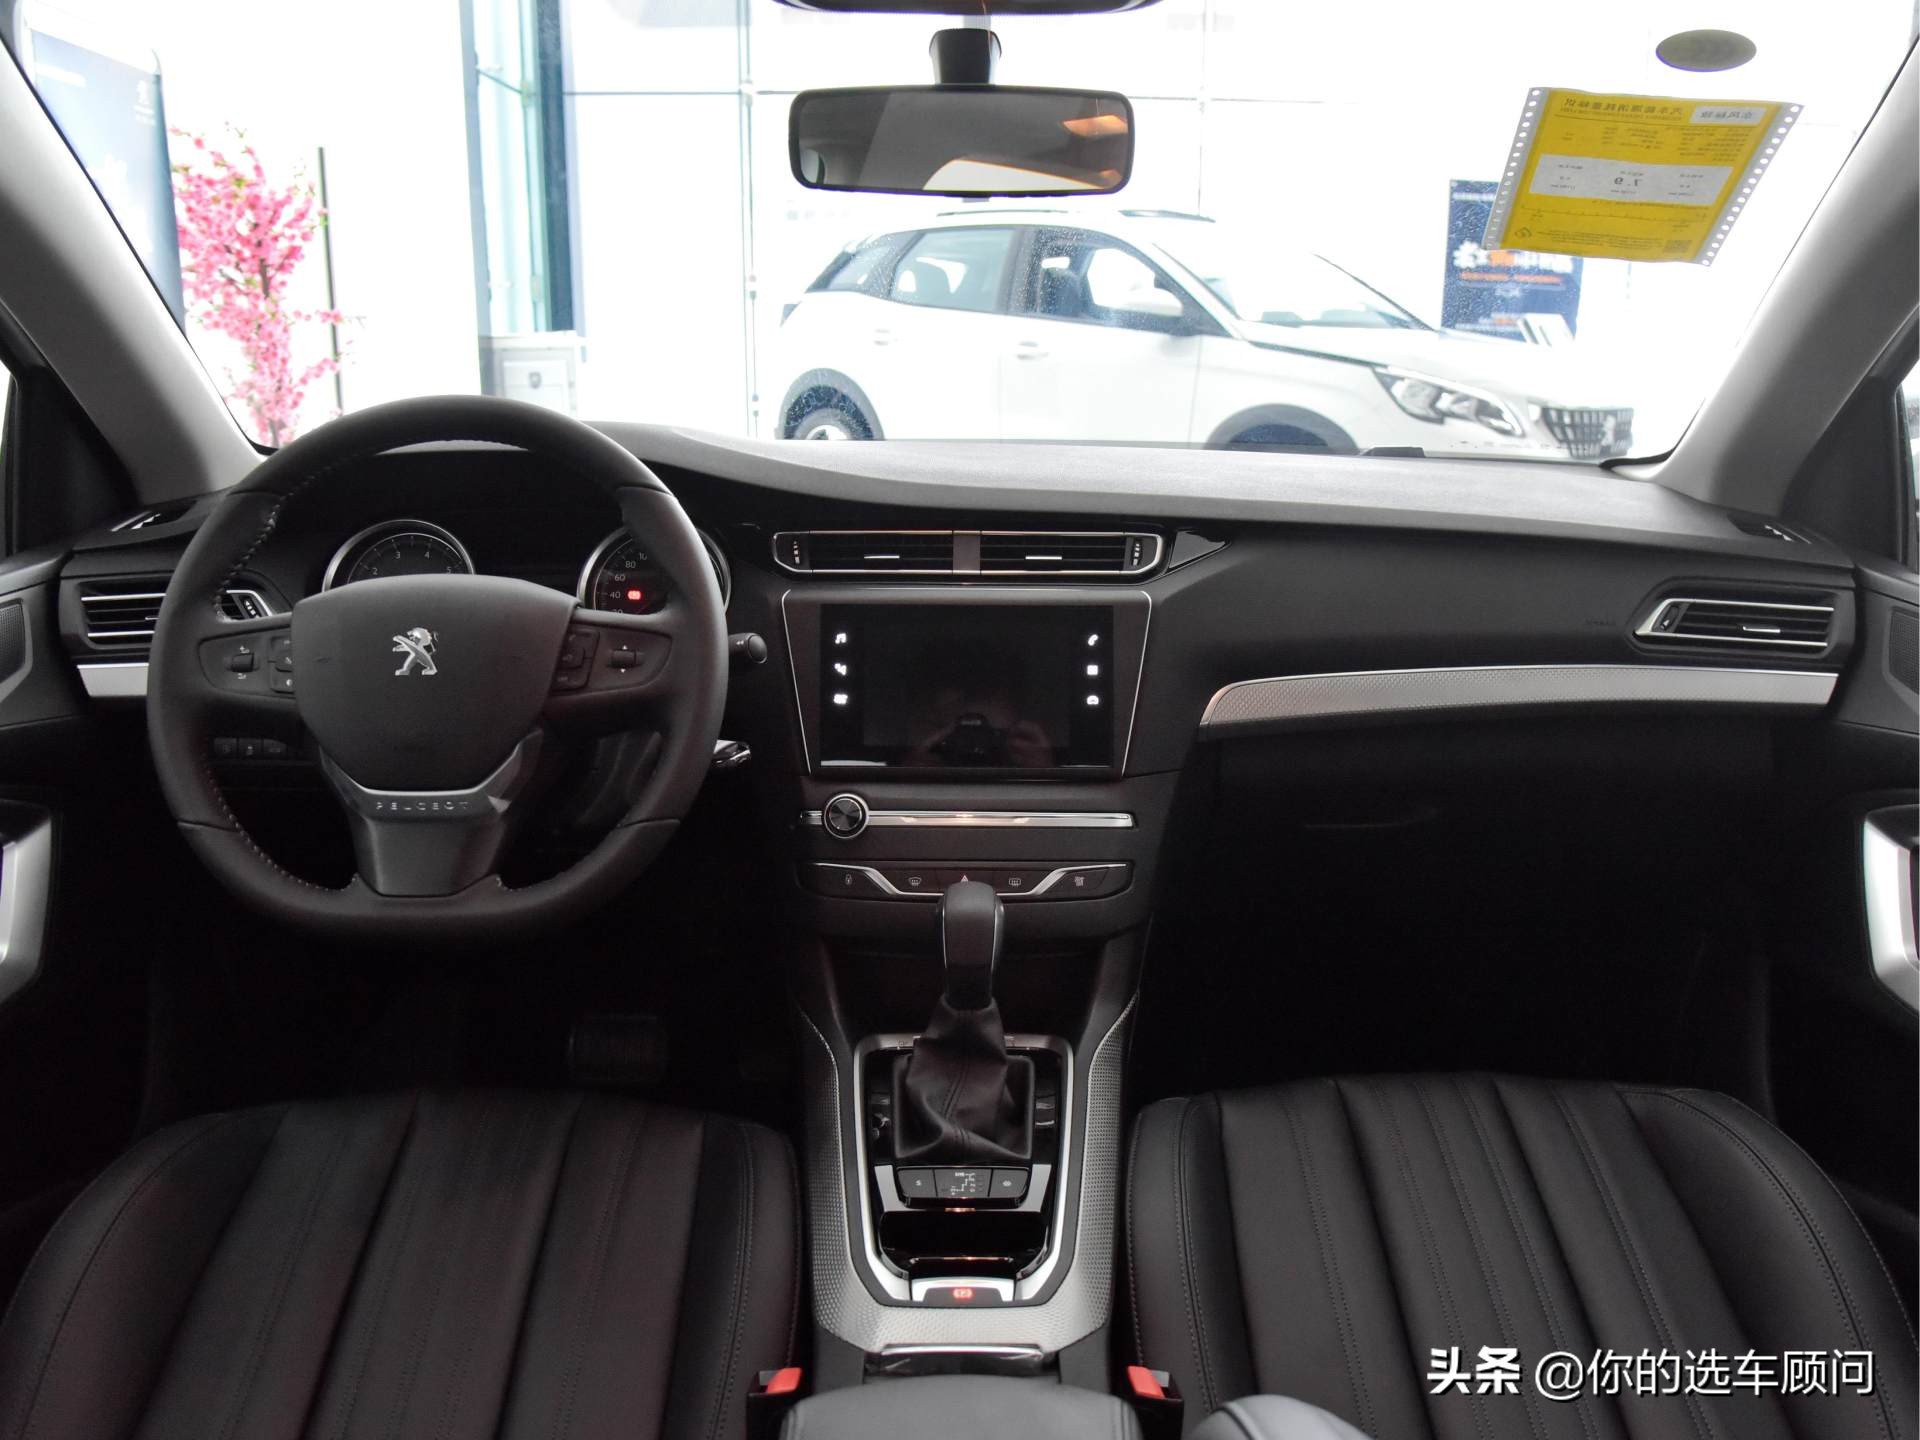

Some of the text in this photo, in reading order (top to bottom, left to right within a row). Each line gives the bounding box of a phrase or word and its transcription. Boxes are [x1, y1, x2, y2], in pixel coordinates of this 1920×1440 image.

[394, 551, 400, 559] 3
[423, 551, 430, 559] 4
[625, 560, 636, 568] 80
[372, 567, 378, 575] 2
[614, 574, 625, 582] 60
[609, 591, 621, 599] 40
